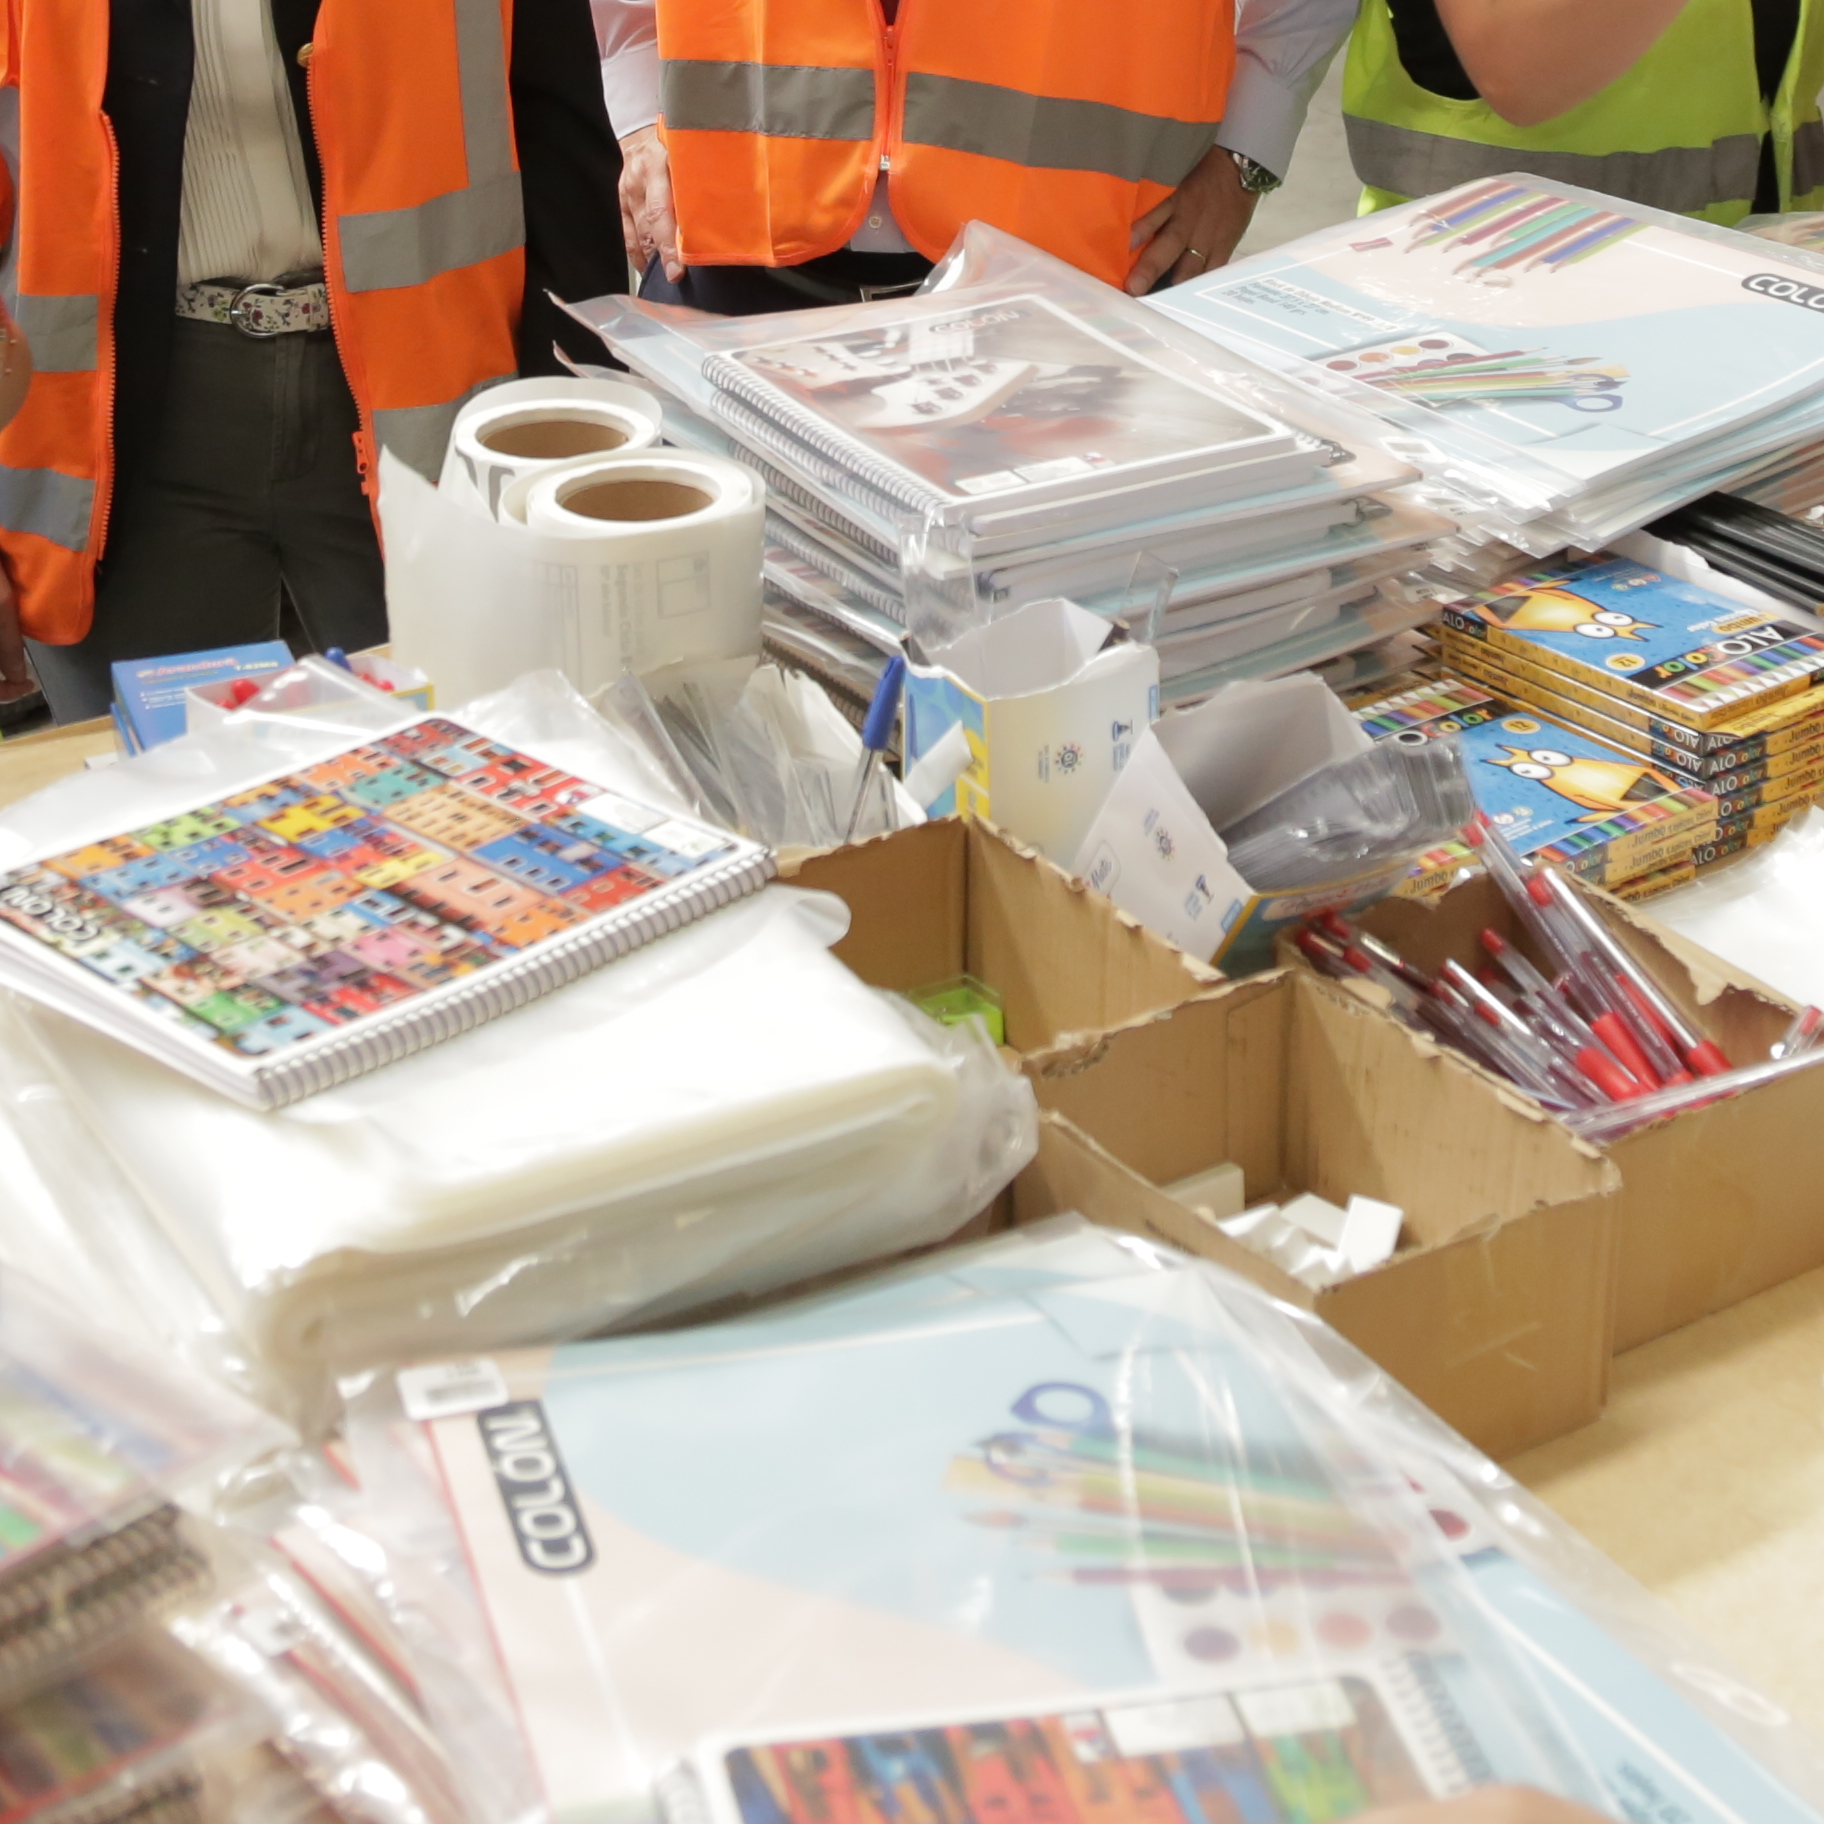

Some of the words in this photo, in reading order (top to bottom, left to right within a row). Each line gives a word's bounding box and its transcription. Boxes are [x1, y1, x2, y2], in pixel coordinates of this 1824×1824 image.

[1789, 742, 1820, 765] Jumbo
[1784, 767, 1817, 791] Jumbo
[1631, 826, 1666, 849] Jumbo
[1630, 846, 1665, 869] Jumbo
